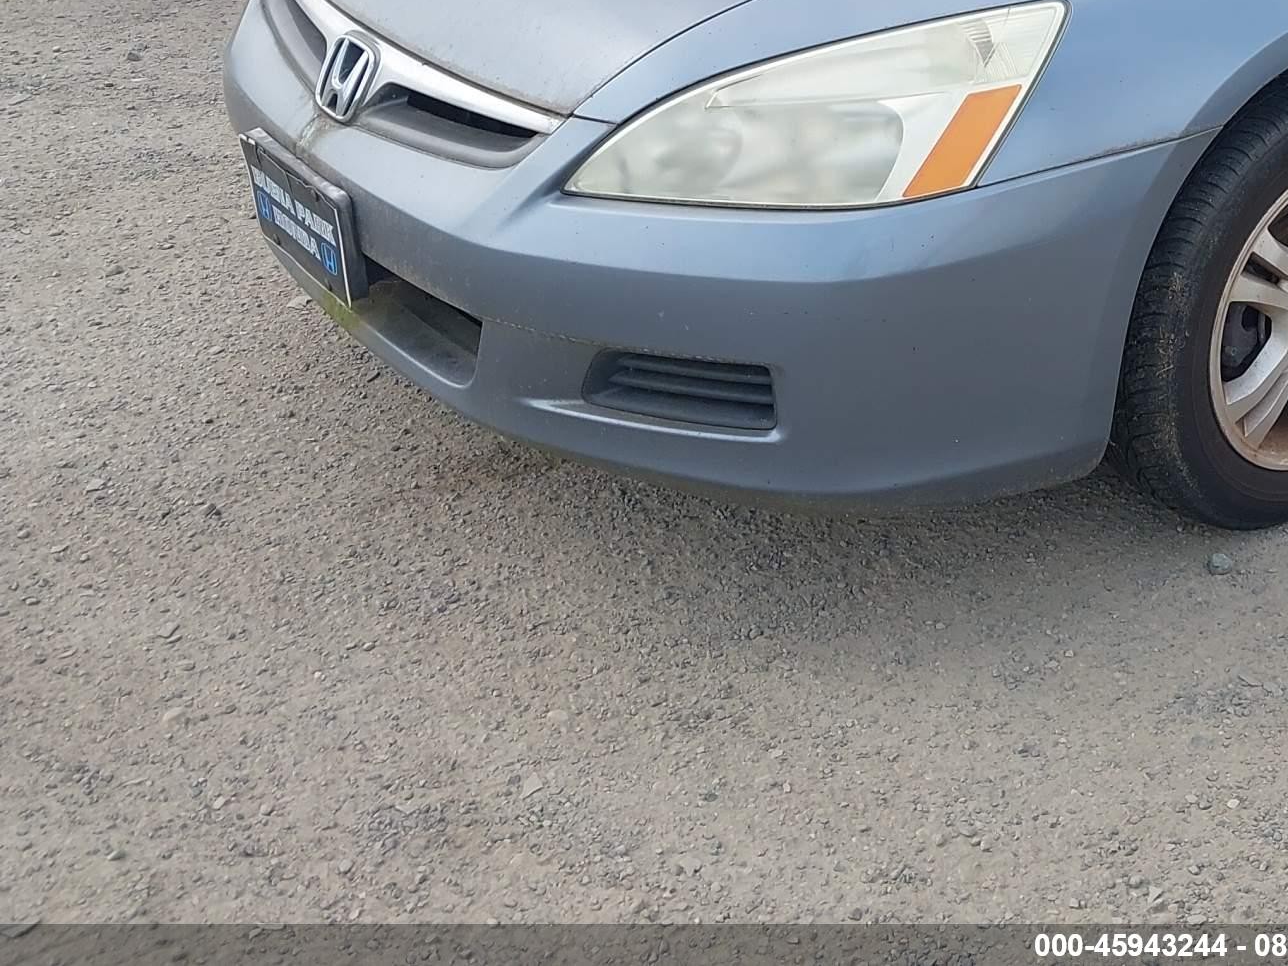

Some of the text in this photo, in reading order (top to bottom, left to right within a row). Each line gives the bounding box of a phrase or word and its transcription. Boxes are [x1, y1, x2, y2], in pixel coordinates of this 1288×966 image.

[251, 165, 336, 248] BUENA PARK
[272, 204, 321, 262] HONDA
